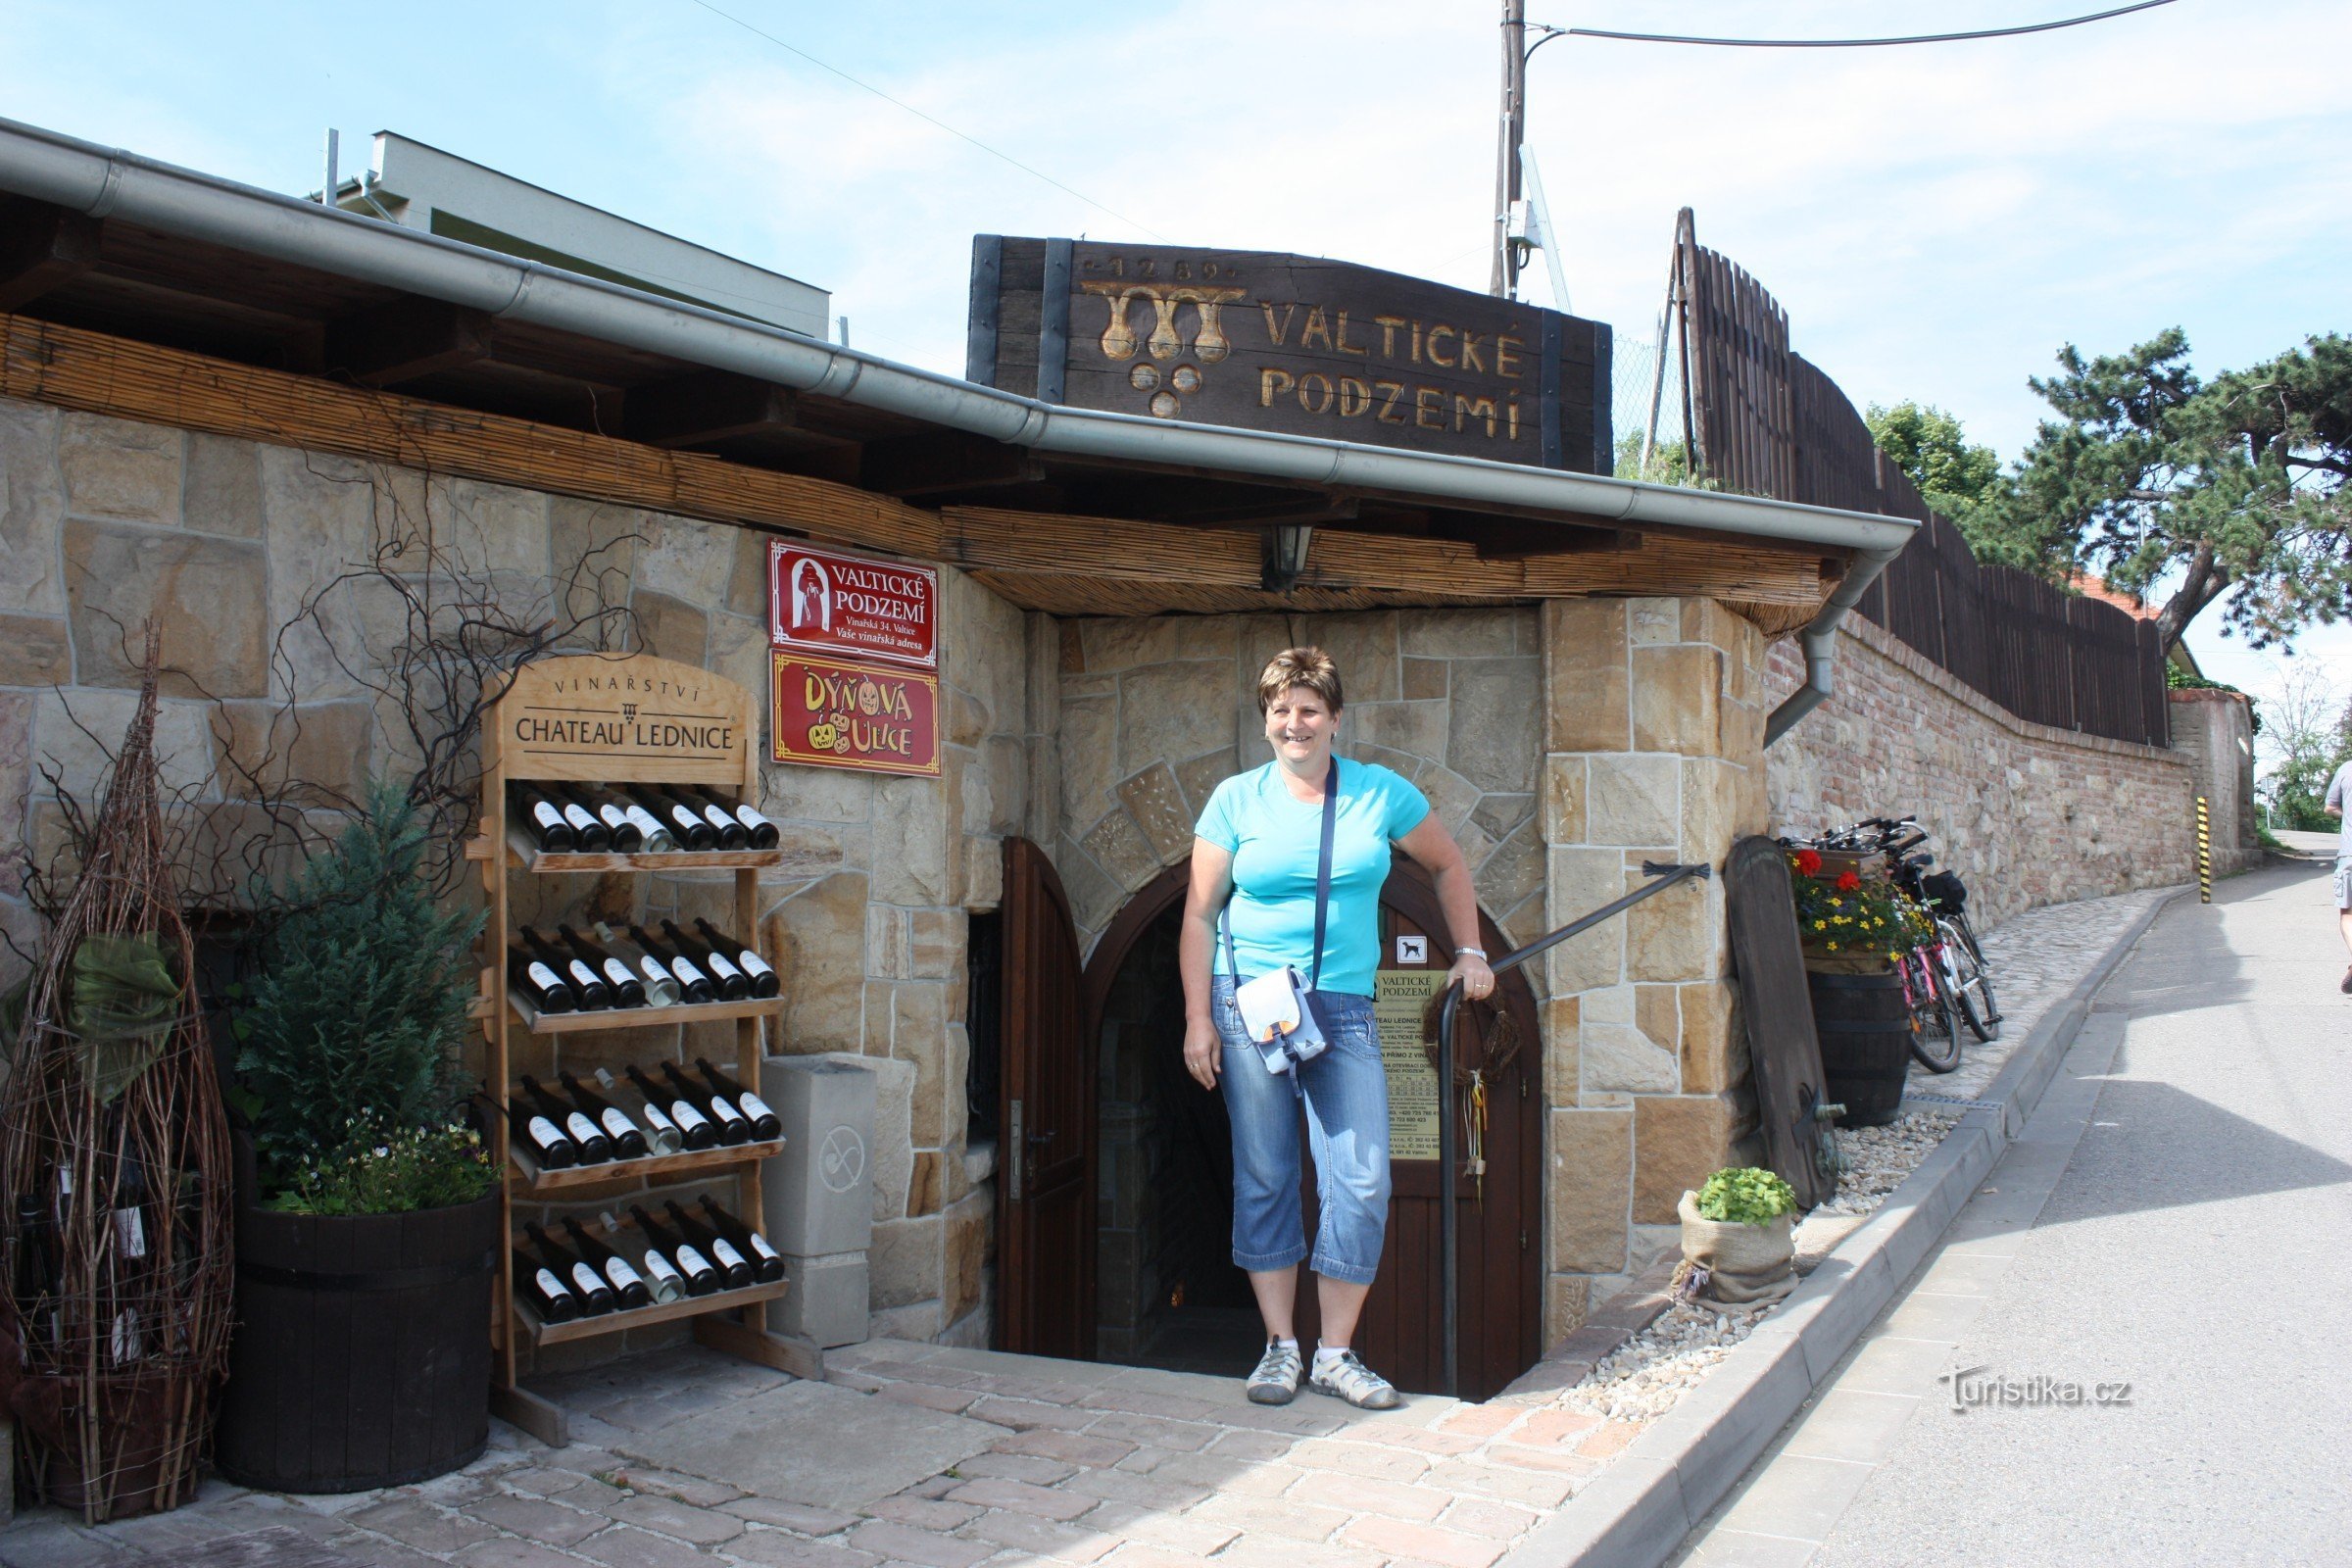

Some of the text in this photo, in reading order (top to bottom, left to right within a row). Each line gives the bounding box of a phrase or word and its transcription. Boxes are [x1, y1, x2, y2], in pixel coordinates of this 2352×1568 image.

[1260, 301, 1524, 378] VALTICKÉ
[1260, 368, 1521, 441] PODZEMÍ
[831, 564, 925, 600] VALTICKÉ
[835, 590, 925, 624] PODZEMÍ
[836, 627, 922, 650] Vaše vinařská adresa
[846, 615, 878, 629] Vinařská
[894, 623, 916, 635] Valtice
[555, 674, 700, 702] VINAŘSTVÍ
[515, 718, 734, 750] CHATEAU LEDNICE
[851, 719, 912, 755] ULICE
[1382, 974, 1432, 985] VALTICKÉ
[1382, 985, 1432, 996] PODZEMÍ
